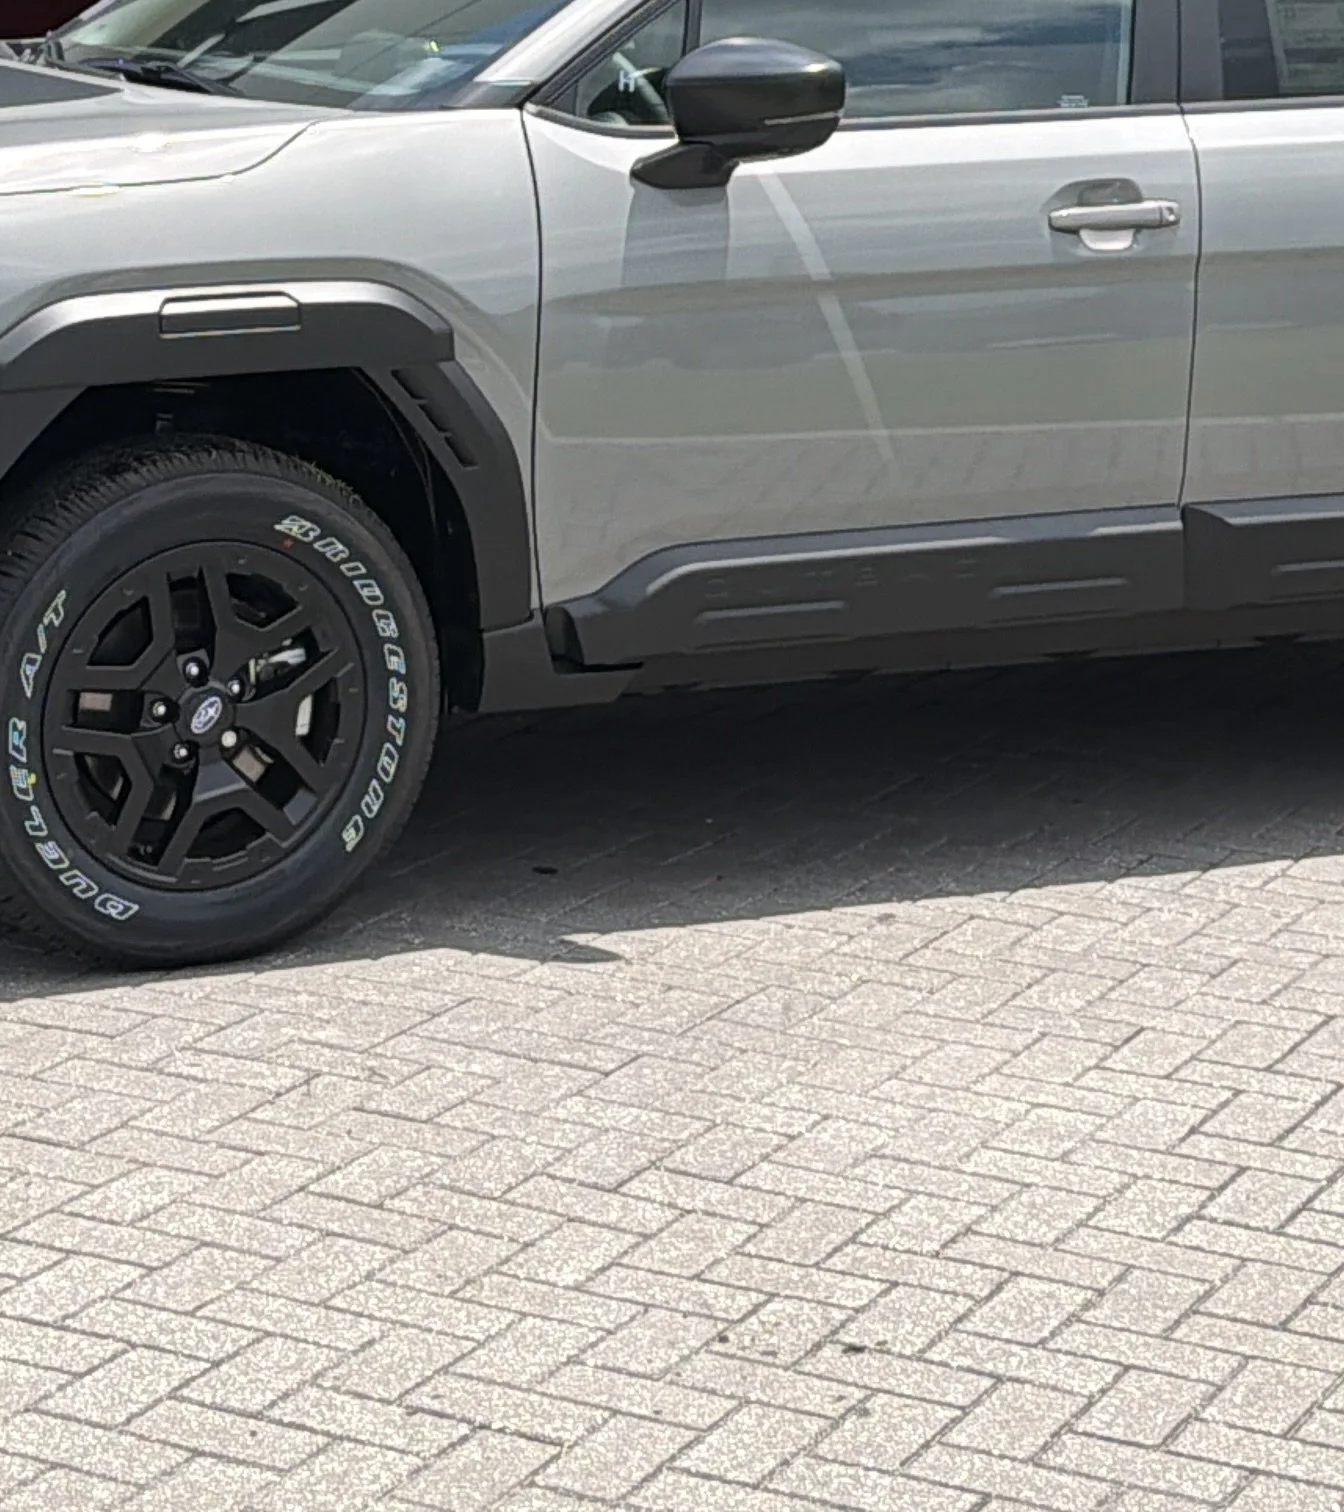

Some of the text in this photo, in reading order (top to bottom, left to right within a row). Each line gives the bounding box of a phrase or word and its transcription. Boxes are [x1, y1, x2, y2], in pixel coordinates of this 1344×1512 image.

[9, 588, 141, 923] DUELER A/T
[272, 514, 408, 855] BRIDGESTONE
